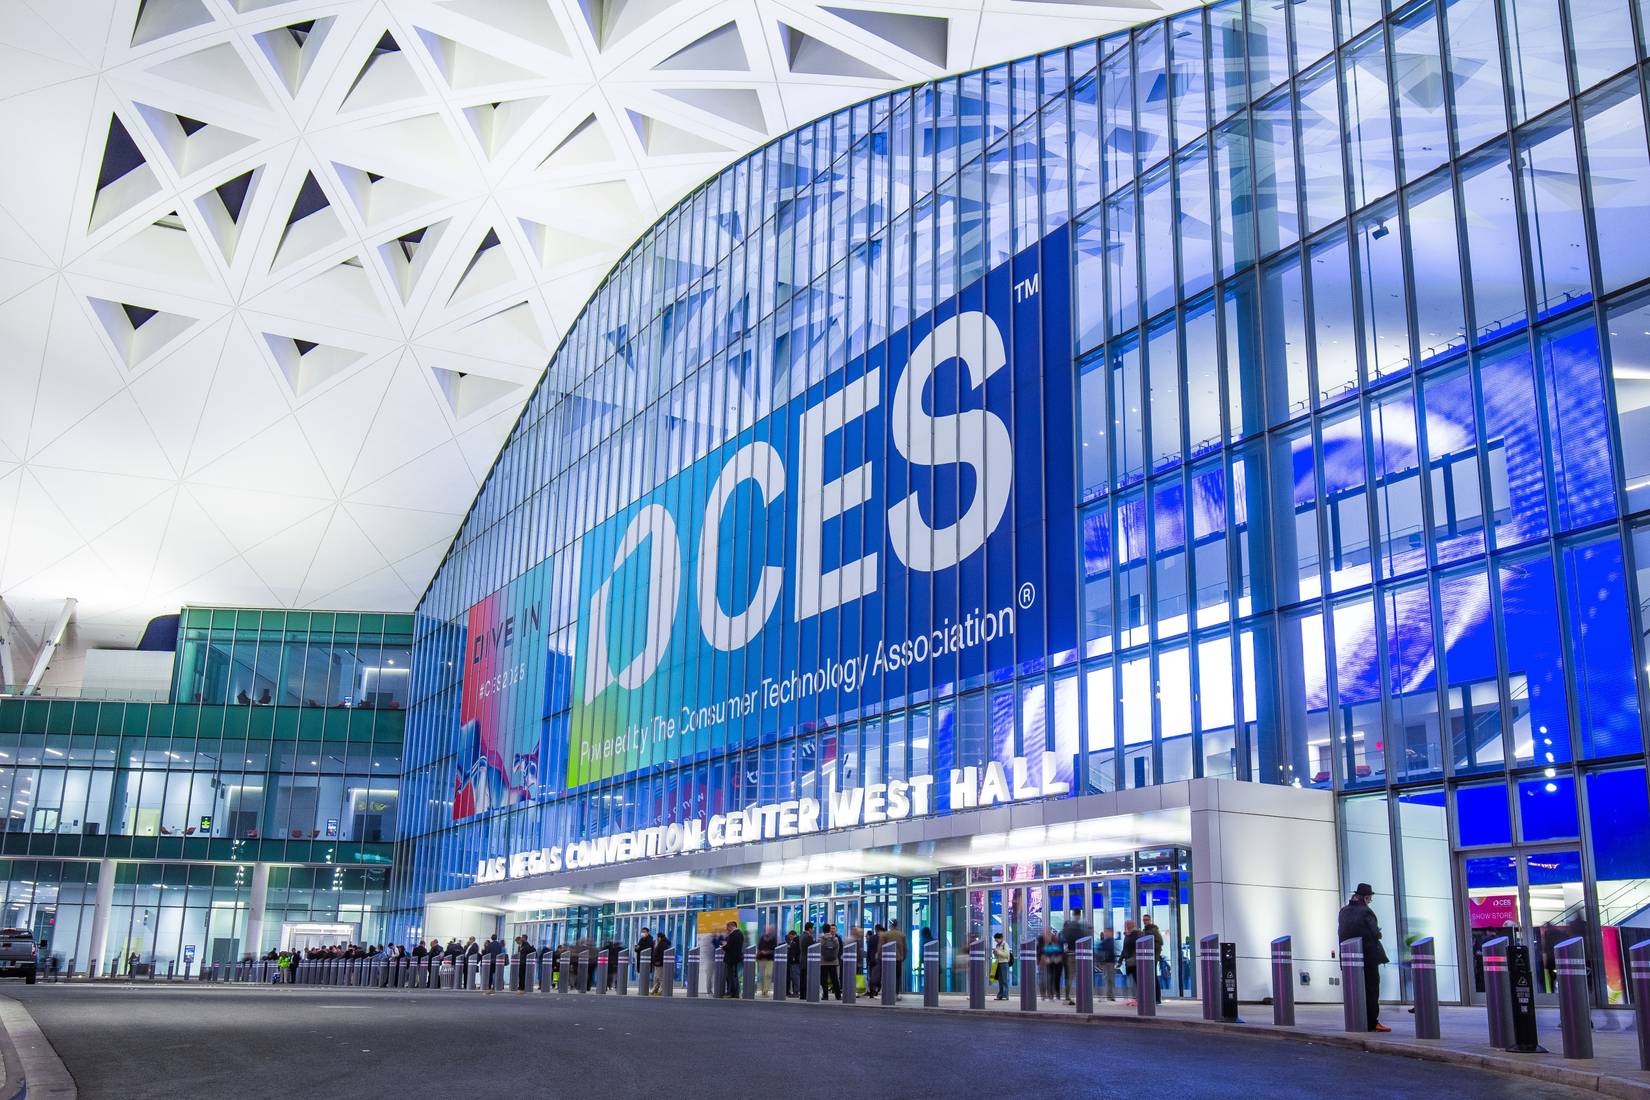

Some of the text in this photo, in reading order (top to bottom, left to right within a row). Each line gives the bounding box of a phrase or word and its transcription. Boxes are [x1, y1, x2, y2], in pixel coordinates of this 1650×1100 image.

[699, 311, 1013, 651] CES
[473, 601, 541, 664] DIVE IN
[580, 725, 630, 766] Powered
[631, 722, 648, 755] by
[652, 715, 675, 743] The
[681, 689, 758, 735] Consumer
[762, 653, 869, 709] Technology
[477, 857, 506, 883] LAS
[509, 847, 562, 877] VEGAS
[566, 821, 702, 866] CONVENTION
[708, 797, 820, 848] CENTER
[828, 774, 933, 829] WEST
[950, 751, 1069, 811] HALL
[1471, 911, 1512, 920] SHOW STORE
